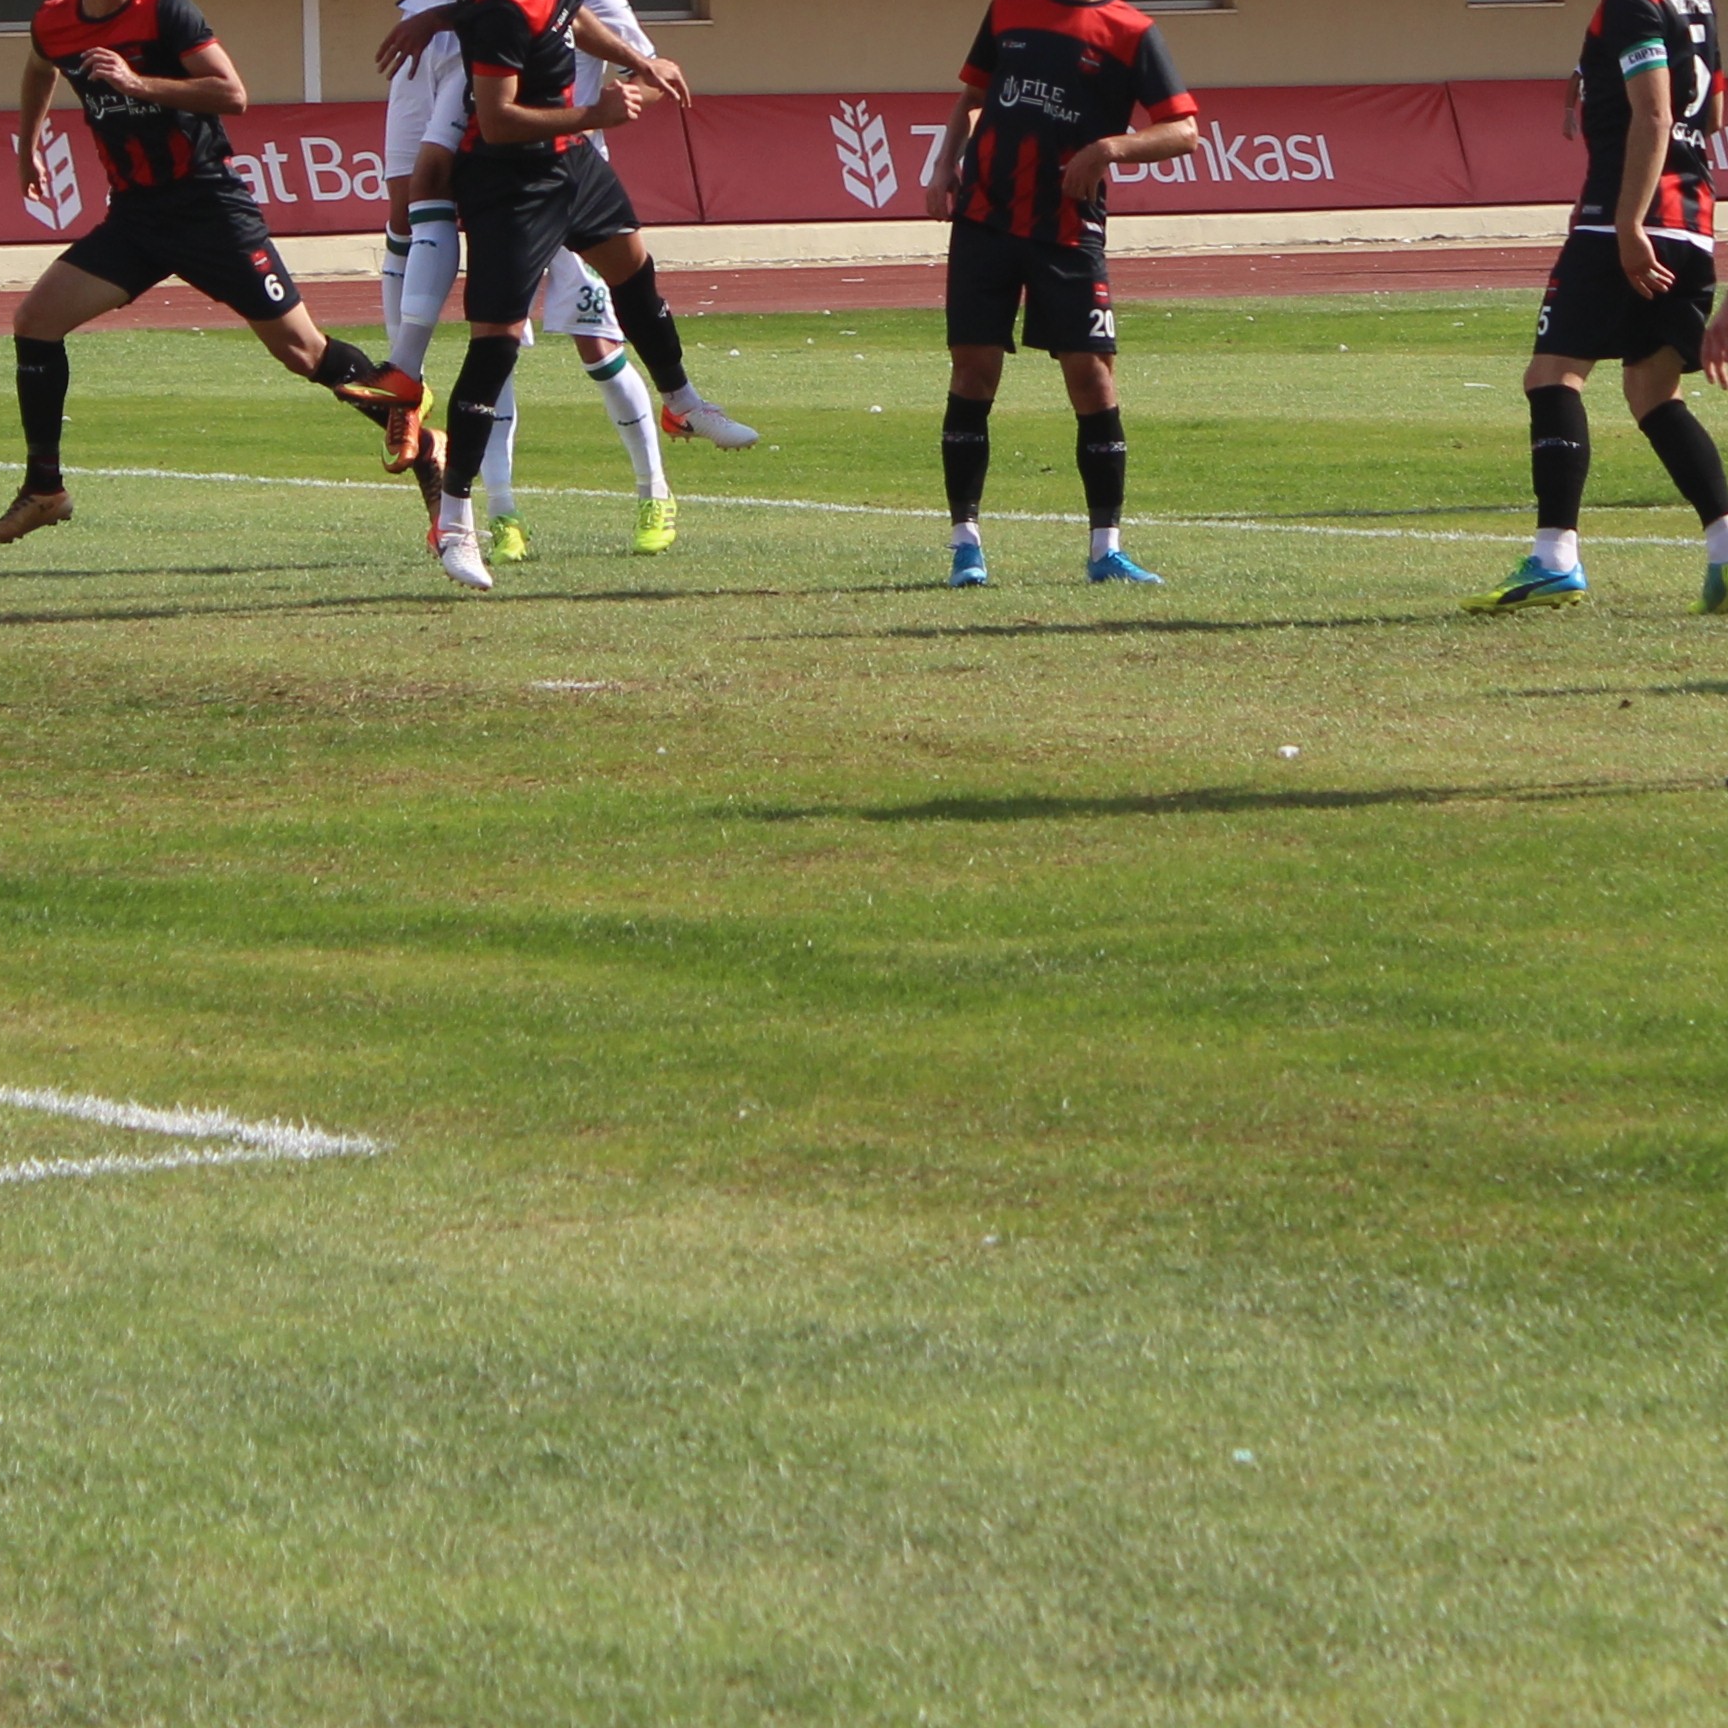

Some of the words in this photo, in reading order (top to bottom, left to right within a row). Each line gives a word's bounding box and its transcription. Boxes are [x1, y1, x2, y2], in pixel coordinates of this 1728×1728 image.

[263, 272, 286, 302] 6
[576, 285, 607, 314] 38
[1089, 308, 1114, 338] 20
[1537, 305, 1552, 336] 5
